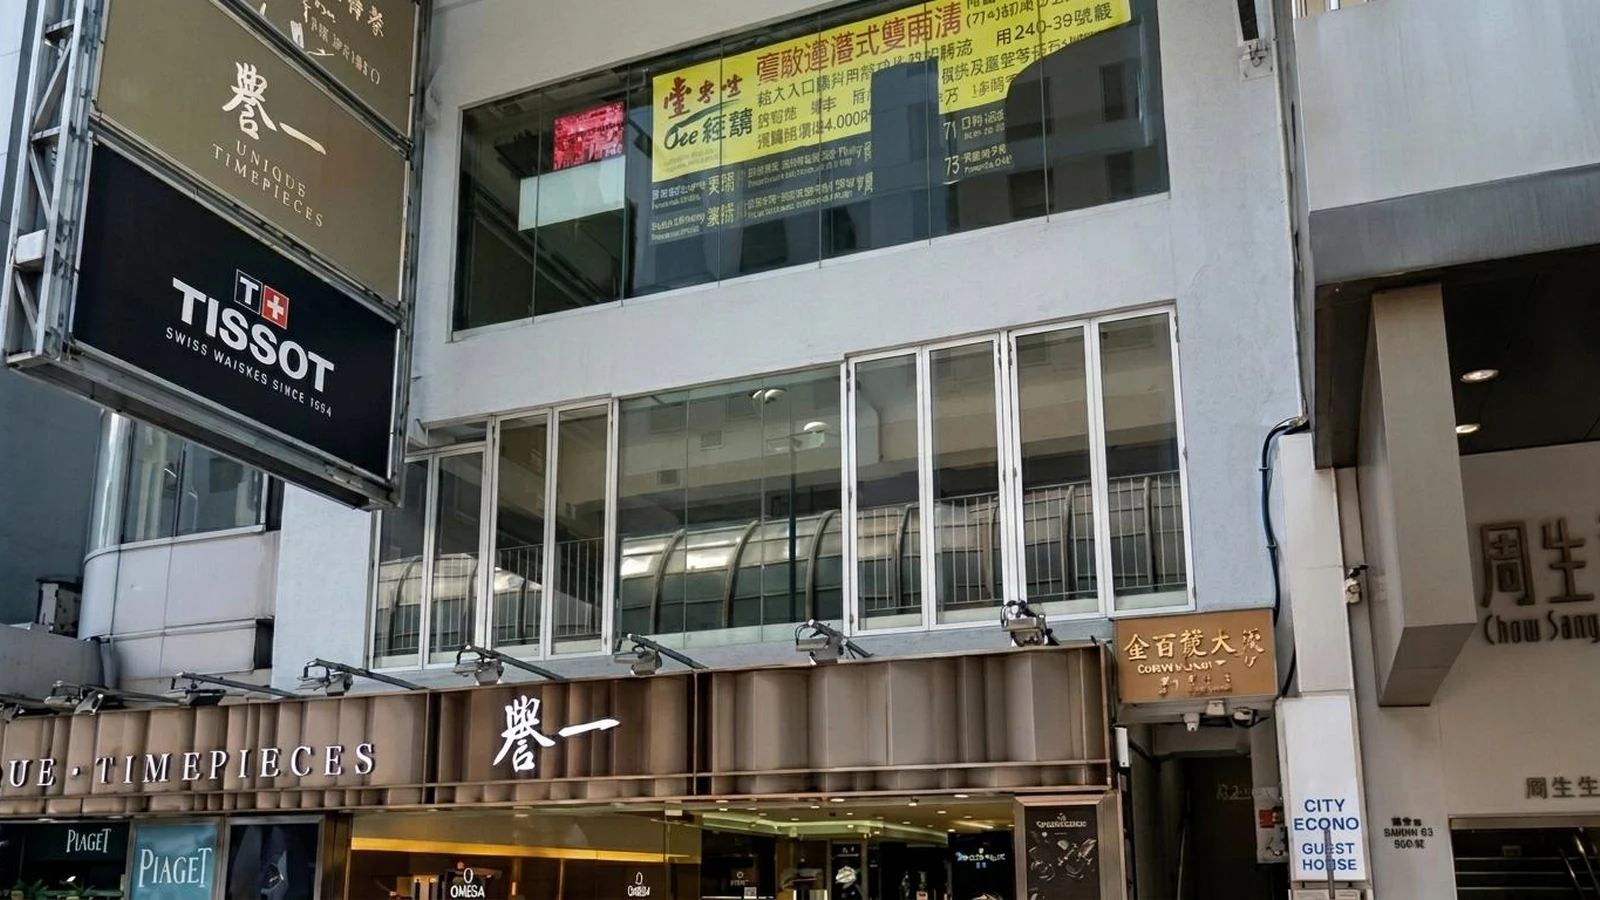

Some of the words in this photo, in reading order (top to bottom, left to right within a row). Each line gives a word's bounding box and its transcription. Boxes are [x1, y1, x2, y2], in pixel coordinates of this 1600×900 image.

[212, 143, 323, 228] TIMEPIECES
[165, 327, 208, 356] SWISS
[172, 276, 335, 393] TISSOT
[1479, 515, 1600, 608] 周生
[2, 757, 55, 787] UE
[95, 741, 377, 784] TIMEPIECES
[1304, 798, 1345, 812] CITY
[66, 828, 111, 853] PIAGET
[1294, 817, 1359, 831] ECONO
[1302, 842, 1355, 855] GUEST
[139, 847, 212, 888] PIAGET
